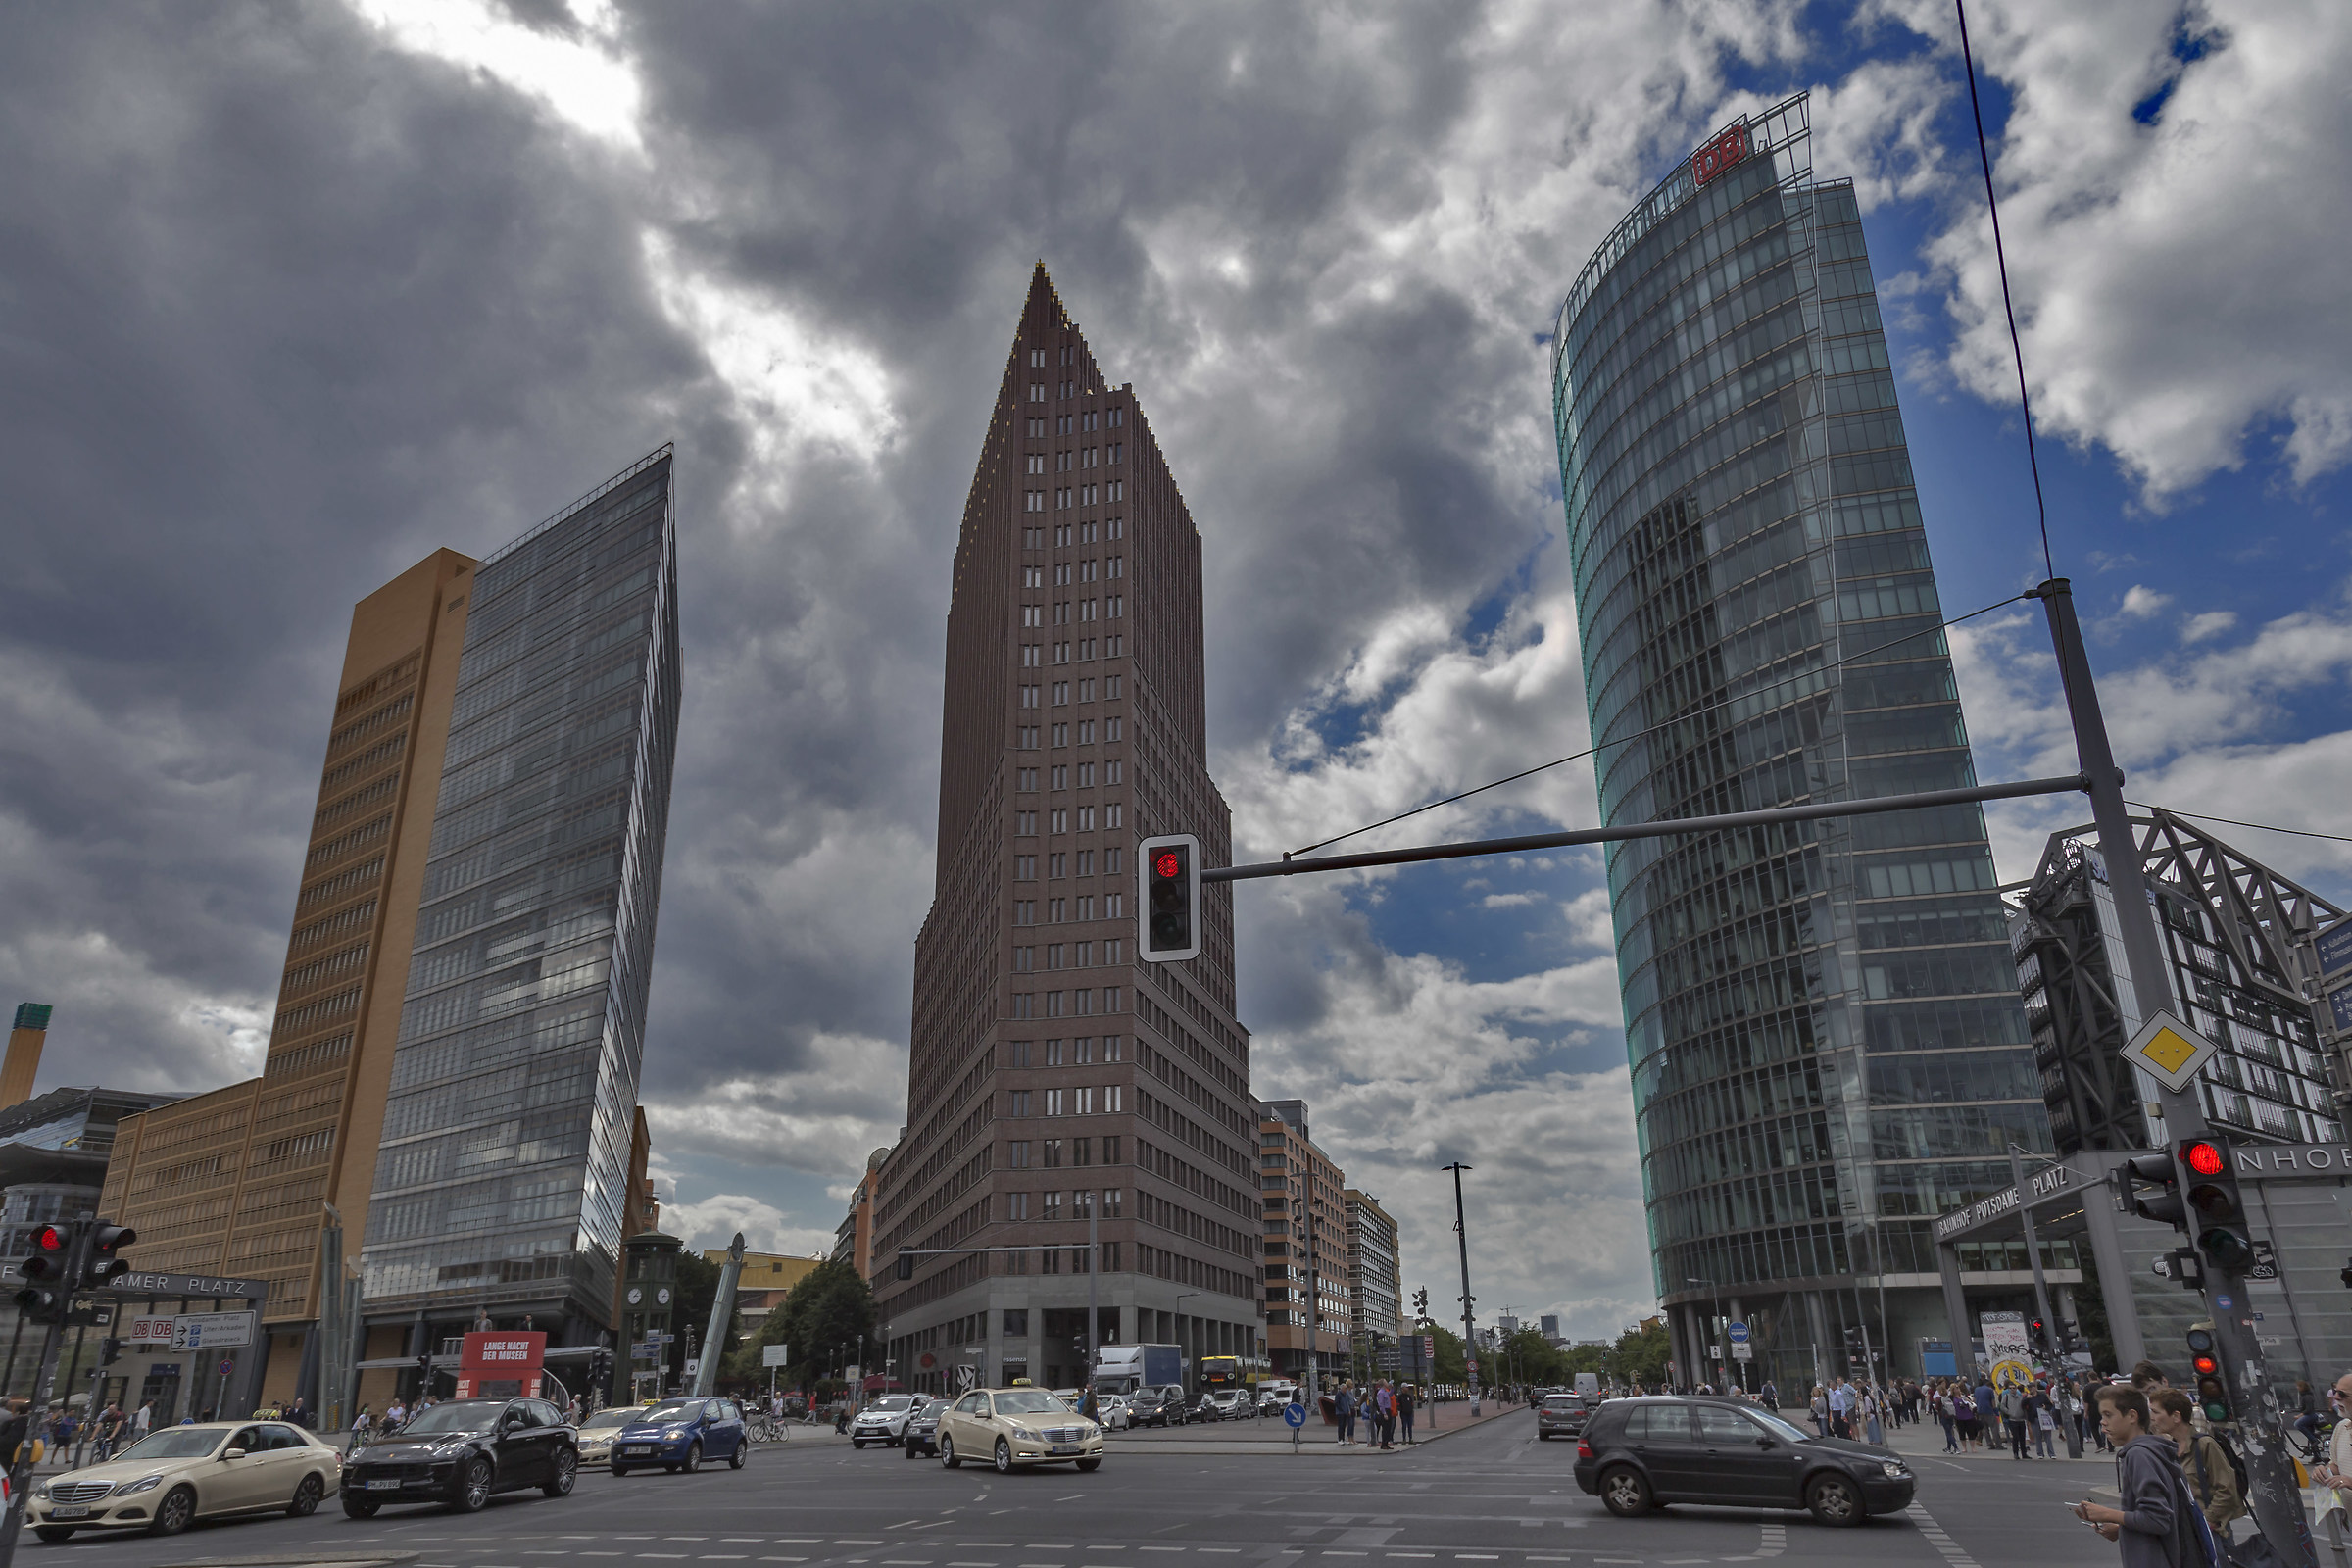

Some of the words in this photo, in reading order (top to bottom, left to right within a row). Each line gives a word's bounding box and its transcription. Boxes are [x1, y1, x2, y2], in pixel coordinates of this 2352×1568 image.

[1696, 131, 1742, 180] DB
[1937, 1208, 1972, 1236] BAHNHOF
[1975, 1187, 2020, 1220] POTSDAME
[2033, 1166, 2068, 1196] PLATZ
[188, 1278, 246, 1294] PLATZ
[483, 1341, 506, 1351] LANGE
[507, 1341, 529, 1350] NACHT
[482, 1351, 497, 1360] DER
[498, 1350, 528, 1360] MUSEEN
